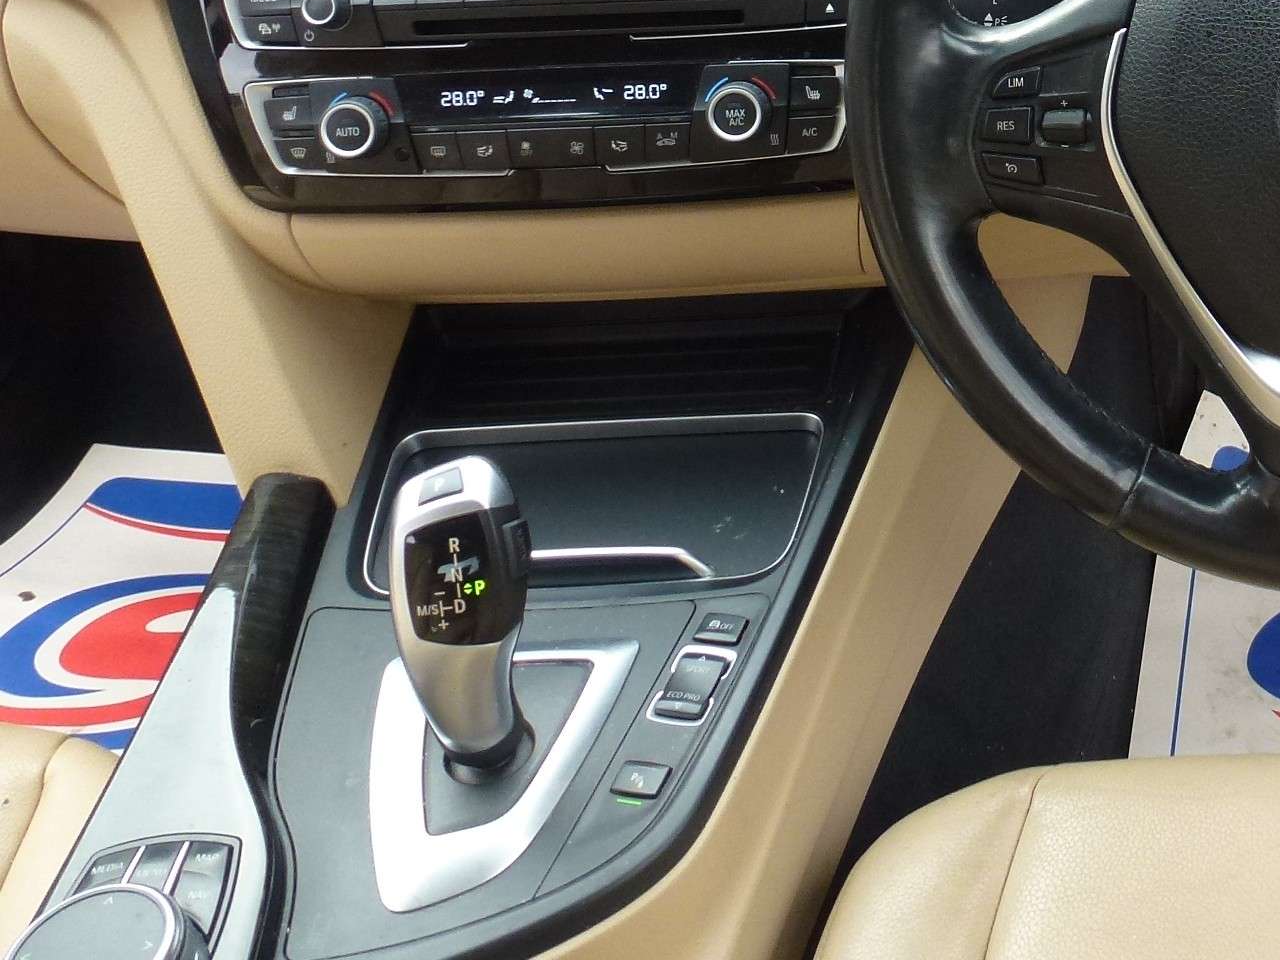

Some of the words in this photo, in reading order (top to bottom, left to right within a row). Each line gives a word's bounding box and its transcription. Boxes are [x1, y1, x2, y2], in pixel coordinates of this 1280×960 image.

[1007, 77, 1024, 88] LIM
[725, 109, 746, 119] MAX
[729, 117, 745, 126] A/C
[996, 120, 1015, 131] RES
[335, 127, 360, 137] AUTO
[802, 127, 819, 137] A/C
[448, 537, 461, 553] R
[474, 579, 486, 596] P
[416, 604, 439, 617] M/S
[453, 598, 467, 615] D
[666, 690, 683, 699] ECO
[683, 693, 701, 701] PRO
